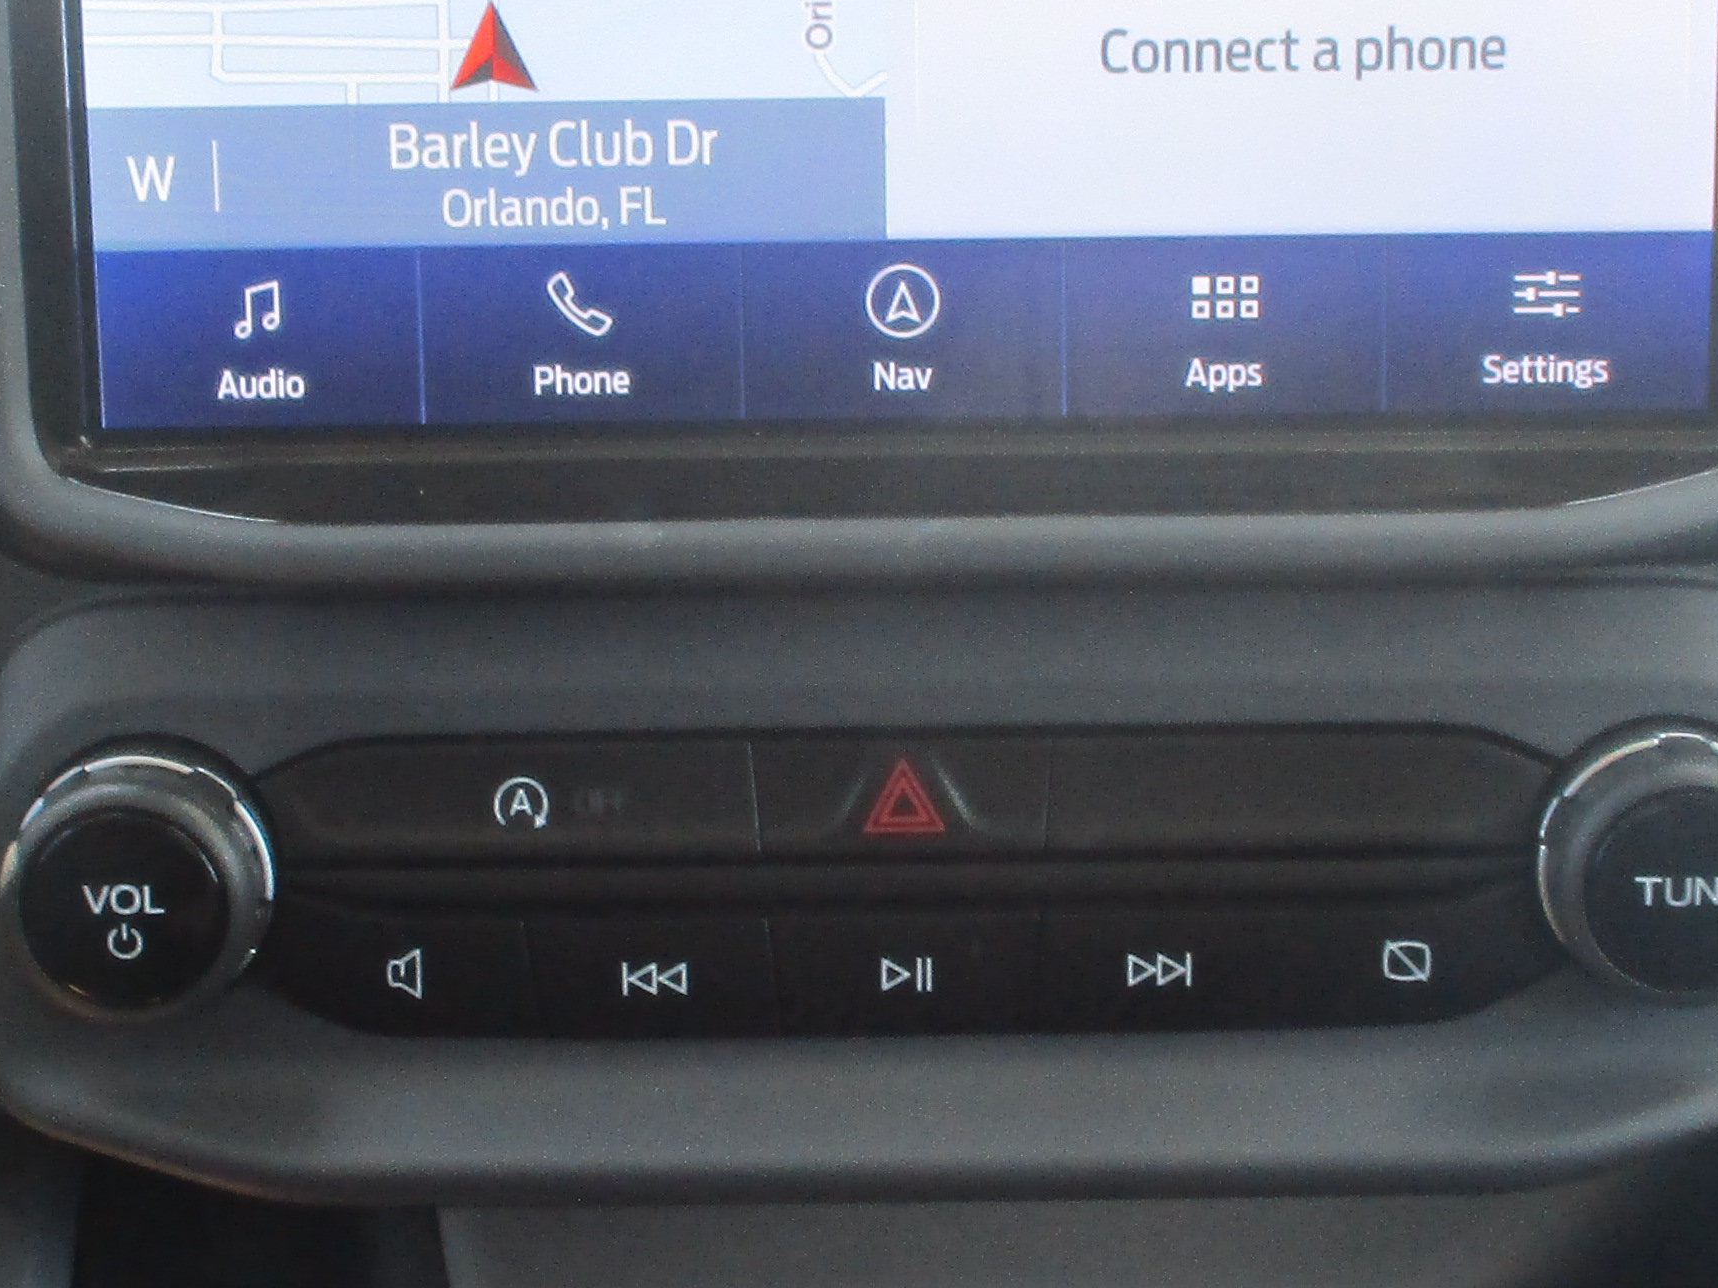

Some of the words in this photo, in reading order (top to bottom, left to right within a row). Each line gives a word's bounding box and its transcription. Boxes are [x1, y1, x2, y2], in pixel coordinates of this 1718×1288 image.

[1100, 27, 1299, 74] Connect
[1314, 38, 1340, 72] a
[1355, 27, 1507, 80] phone
[388, 124, 538, 174] Barley
[548, 122, 656, 167] Club
[665, 120, 719, 167] Dr
[129, 156, 176, 203] W
[441, 189, 610, 232] Orlando,
[620, 187, 667, 226] FL
[218, 367, 305, 401] Audio
[533, 364, 630, 396] Phone
[872, 361, 933, 391] Nav
[1185, 357, 1263, 392] Apps
[1483, 352, 1609, 388] Settings
[83, 885, 165, 914] VOL
